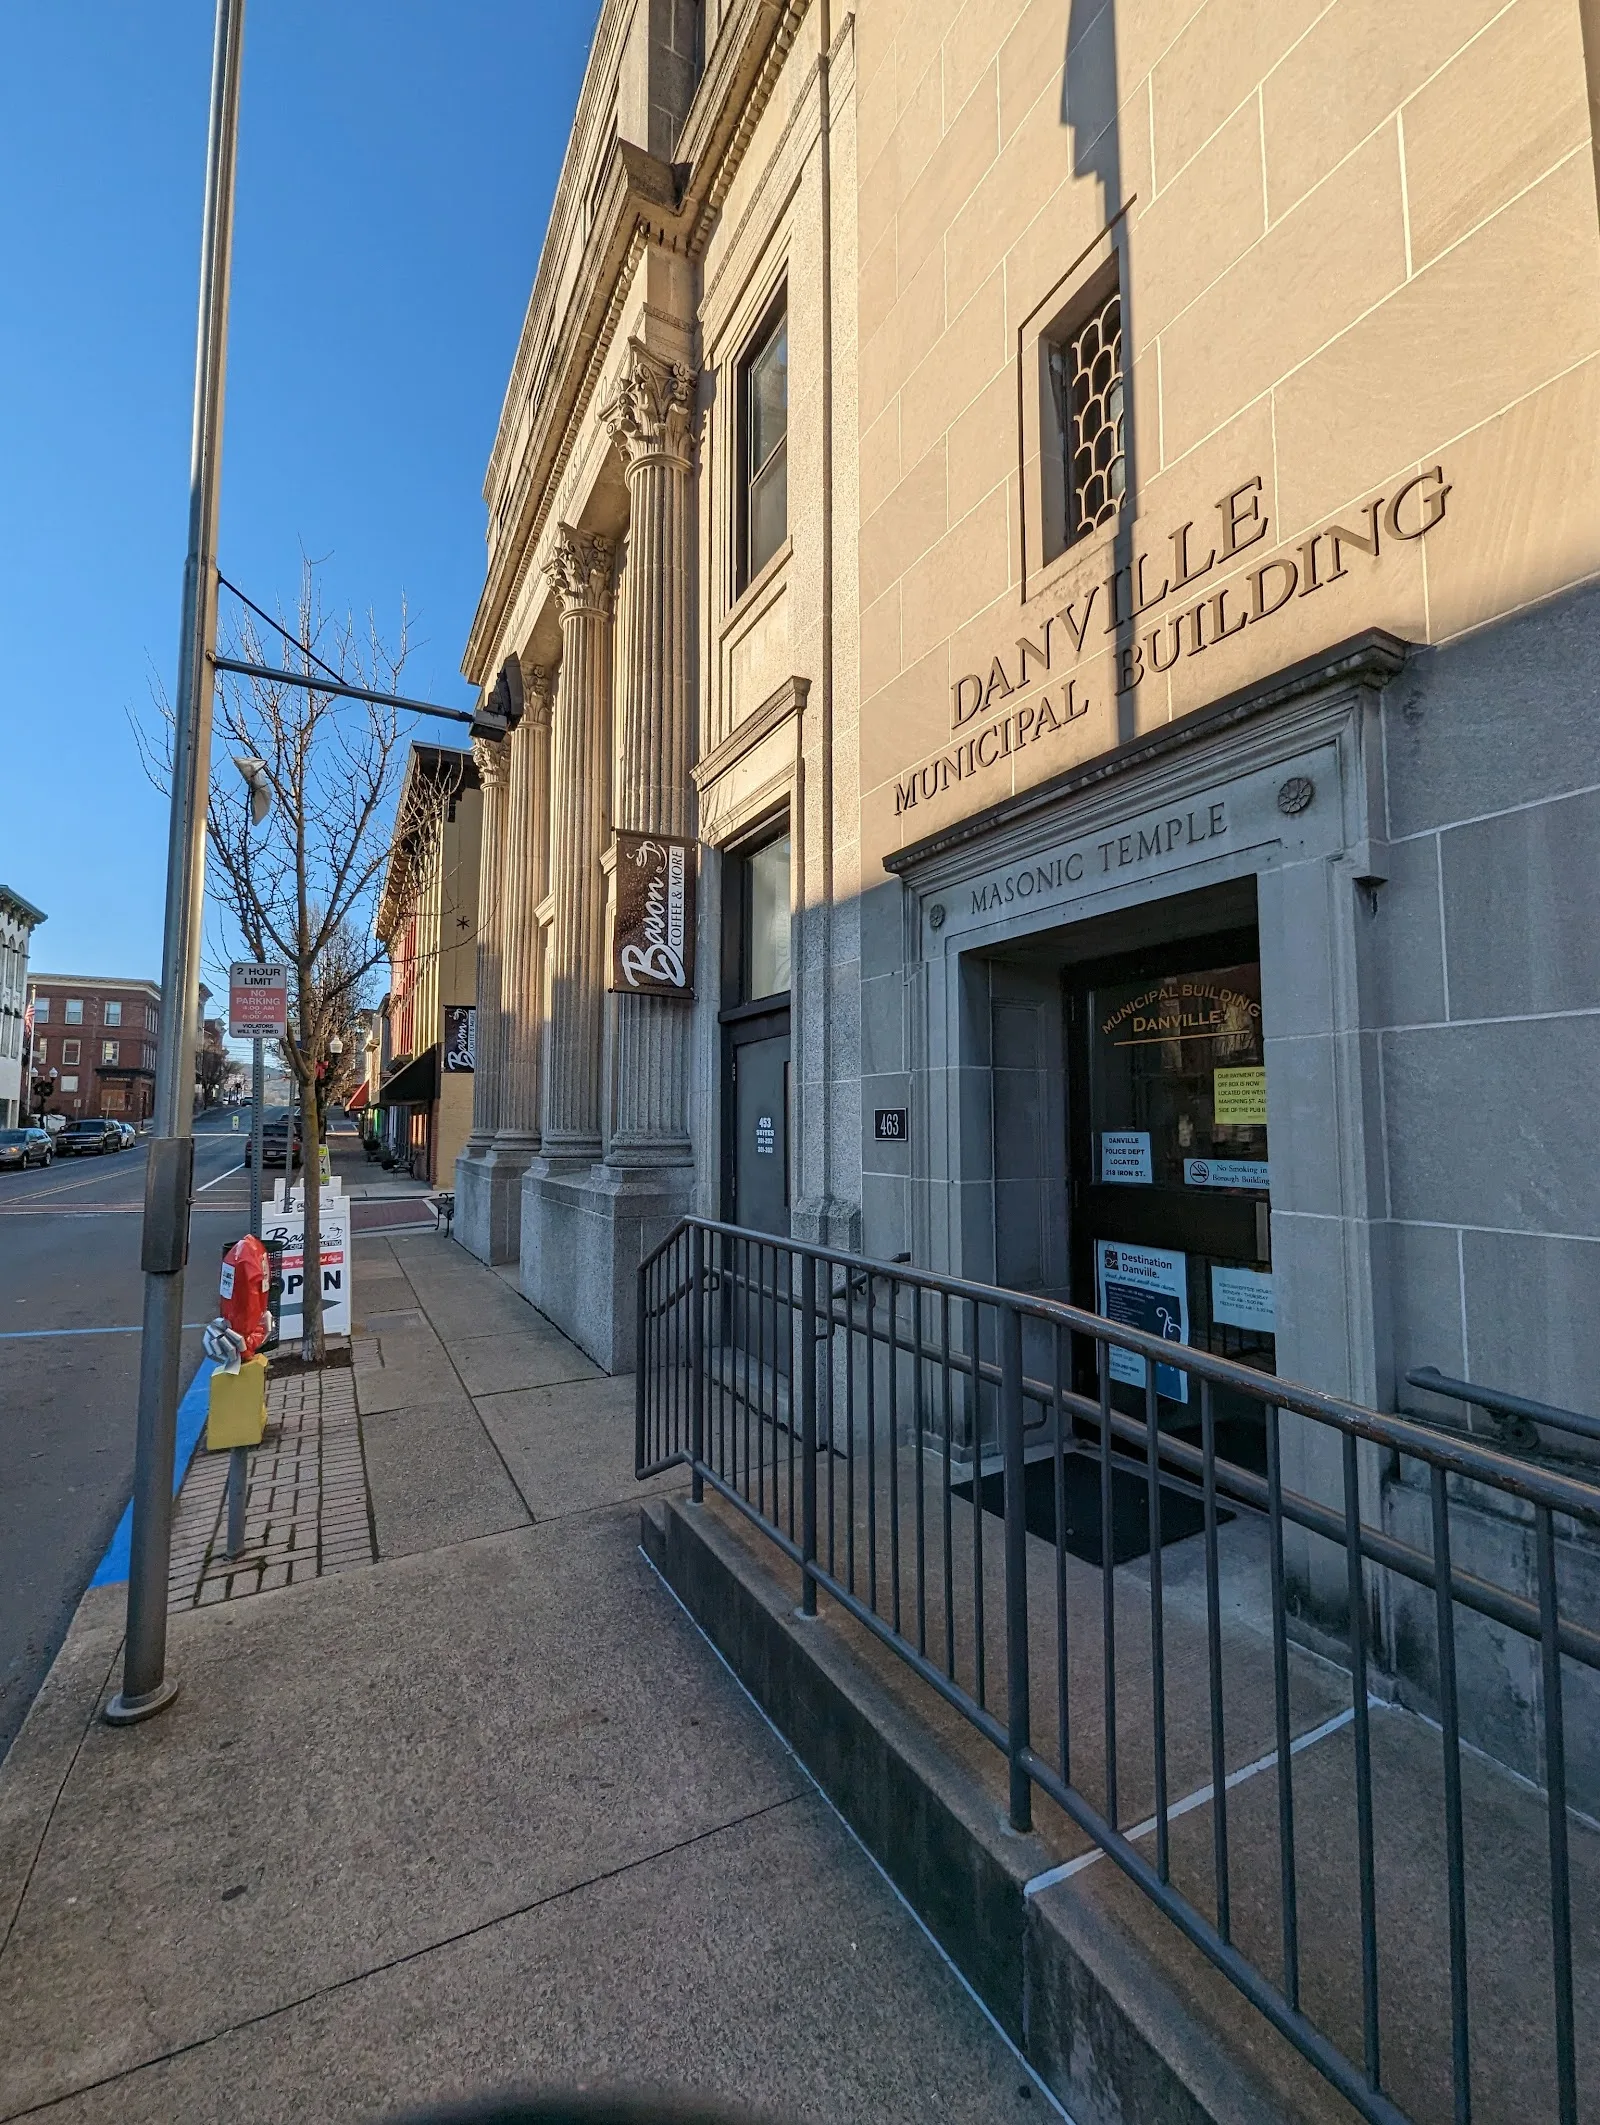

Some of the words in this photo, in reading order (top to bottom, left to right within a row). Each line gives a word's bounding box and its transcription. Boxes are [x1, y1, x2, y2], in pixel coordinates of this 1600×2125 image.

[950, 475, 1269, 731] DANVILLE
[893, 679, 1090, 816] MUNICIPAL
[1114, 465, 1453, 696] BUILDING
[971, 853, 1084, 915] MASONIC
[1098, 802, 1228, 873] TEMPLE
[671, 851, 684, 889] MORE
[675, 890, 682, 900] &
[621, 876, 686, 988] Bason
[670, 902, 682, 947] COFFEE
[236, 967, 244, 975] 2
[248, 968, 281, 976] HOUR
[244, 977, 273, 986] LIMIT
[236, 997, 280, 1006] PARKING
[250, 989, 266, 997] NO
[1101, 986, 1179, 1035] MUNICIPAL
[1182, 984, 1262, 1017] BUILDING
[1133, 1010, 1222, 1033] DANVILLE
[758, 1117, 772, 1129] 453
[880, 1113, 899, 1136] 463
[1212, 1174, 1240, 1183] Borough
[1216, 1164, 1227, 1172] No
[1228, 1164, 1258, 1174] Smoking
[1260, 1166, 1268, 1174] in
[265, 1227, 326, 1250] Basn
[1121, 1252, 1173, 1270] Destination
[1122, 1263, 1160, 1279] Danville.
